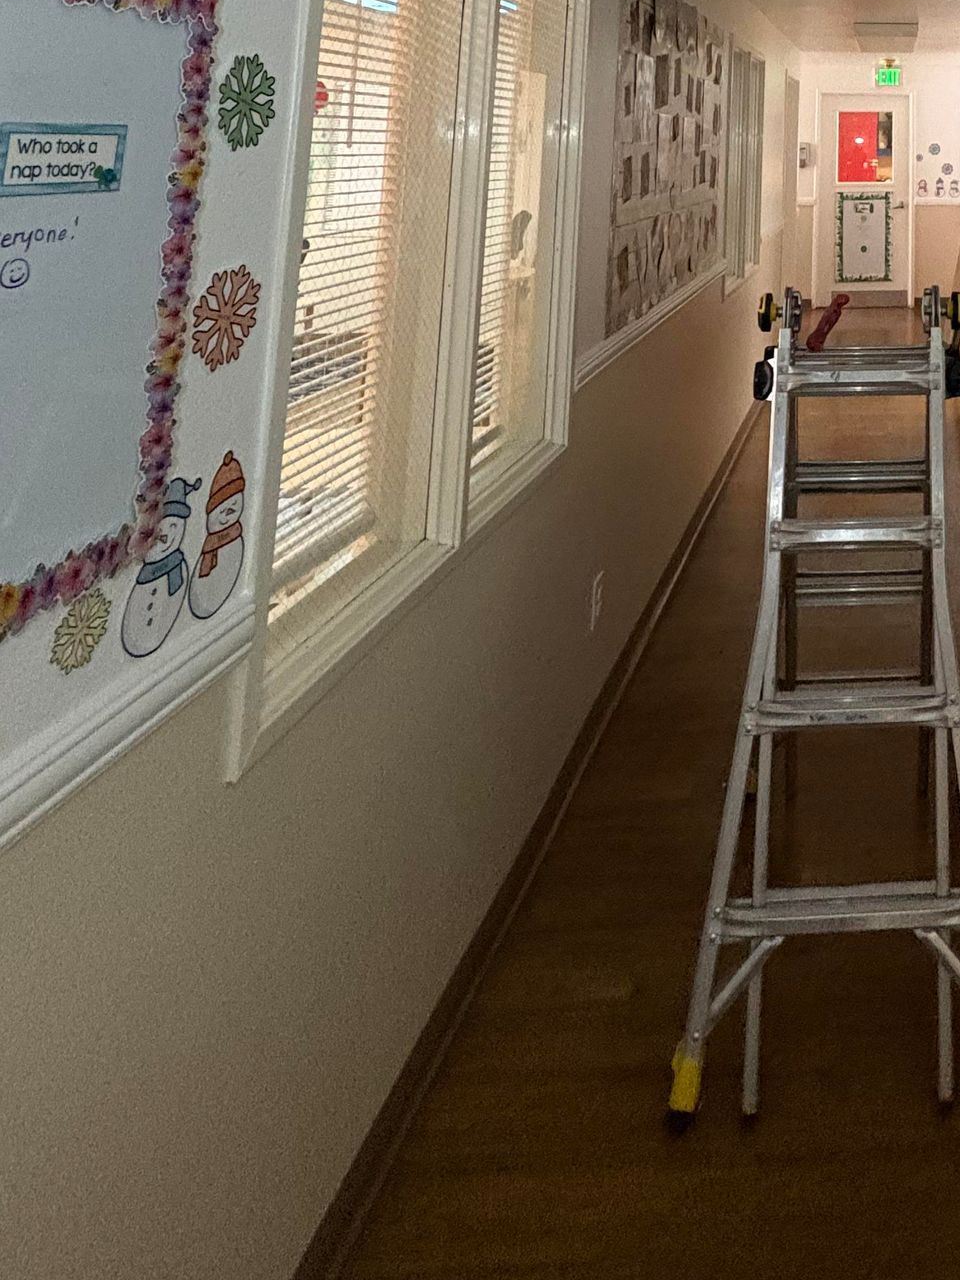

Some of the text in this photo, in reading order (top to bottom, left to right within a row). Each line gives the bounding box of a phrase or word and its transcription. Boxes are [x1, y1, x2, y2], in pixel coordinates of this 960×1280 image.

[17, 138, 98, 154] Who took a
[10, 161, 96, 181] nap today?
[0, 216, 79, 252] eryone!
